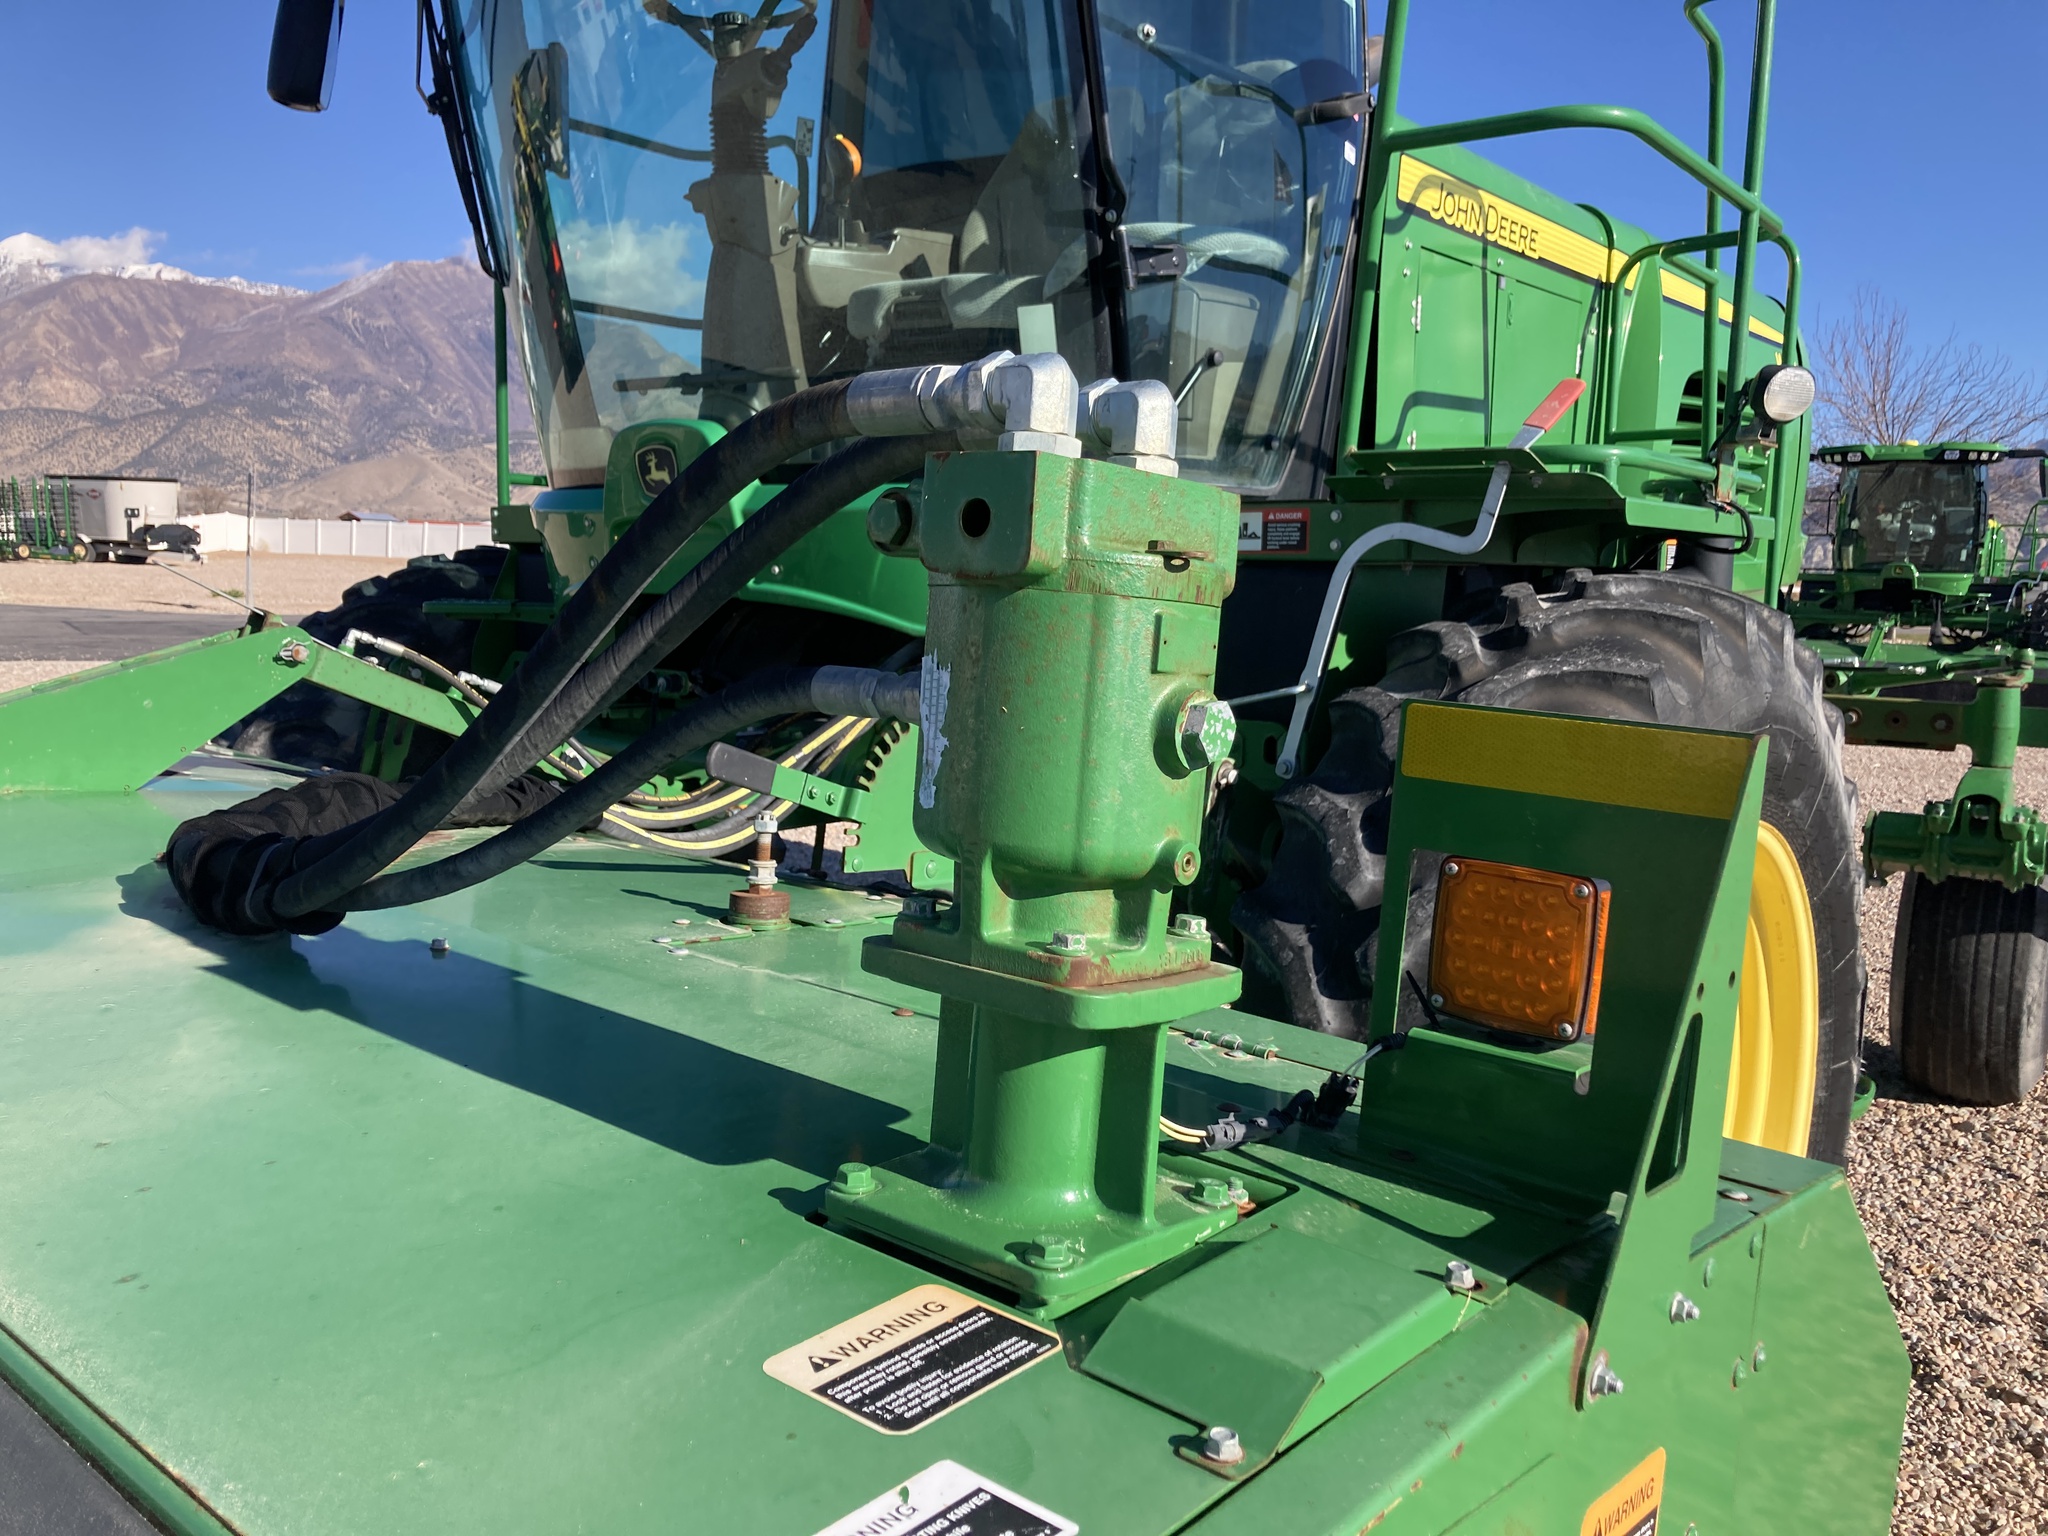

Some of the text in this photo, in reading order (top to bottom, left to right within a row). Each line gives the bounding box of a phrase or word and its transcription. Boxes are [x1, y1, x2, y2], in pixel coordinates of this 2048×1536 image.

[1432, 182, 1540, 253] JOHN DEERE
[829, 1301, 948, 1357] WARNING
[886, 1396, 907, 1410] Look
[848, 1503, 918, 1536] NING
[946, 1492, 991, 1522] KNIVES
[1604, 1477, 1655, 1535] WARNING
